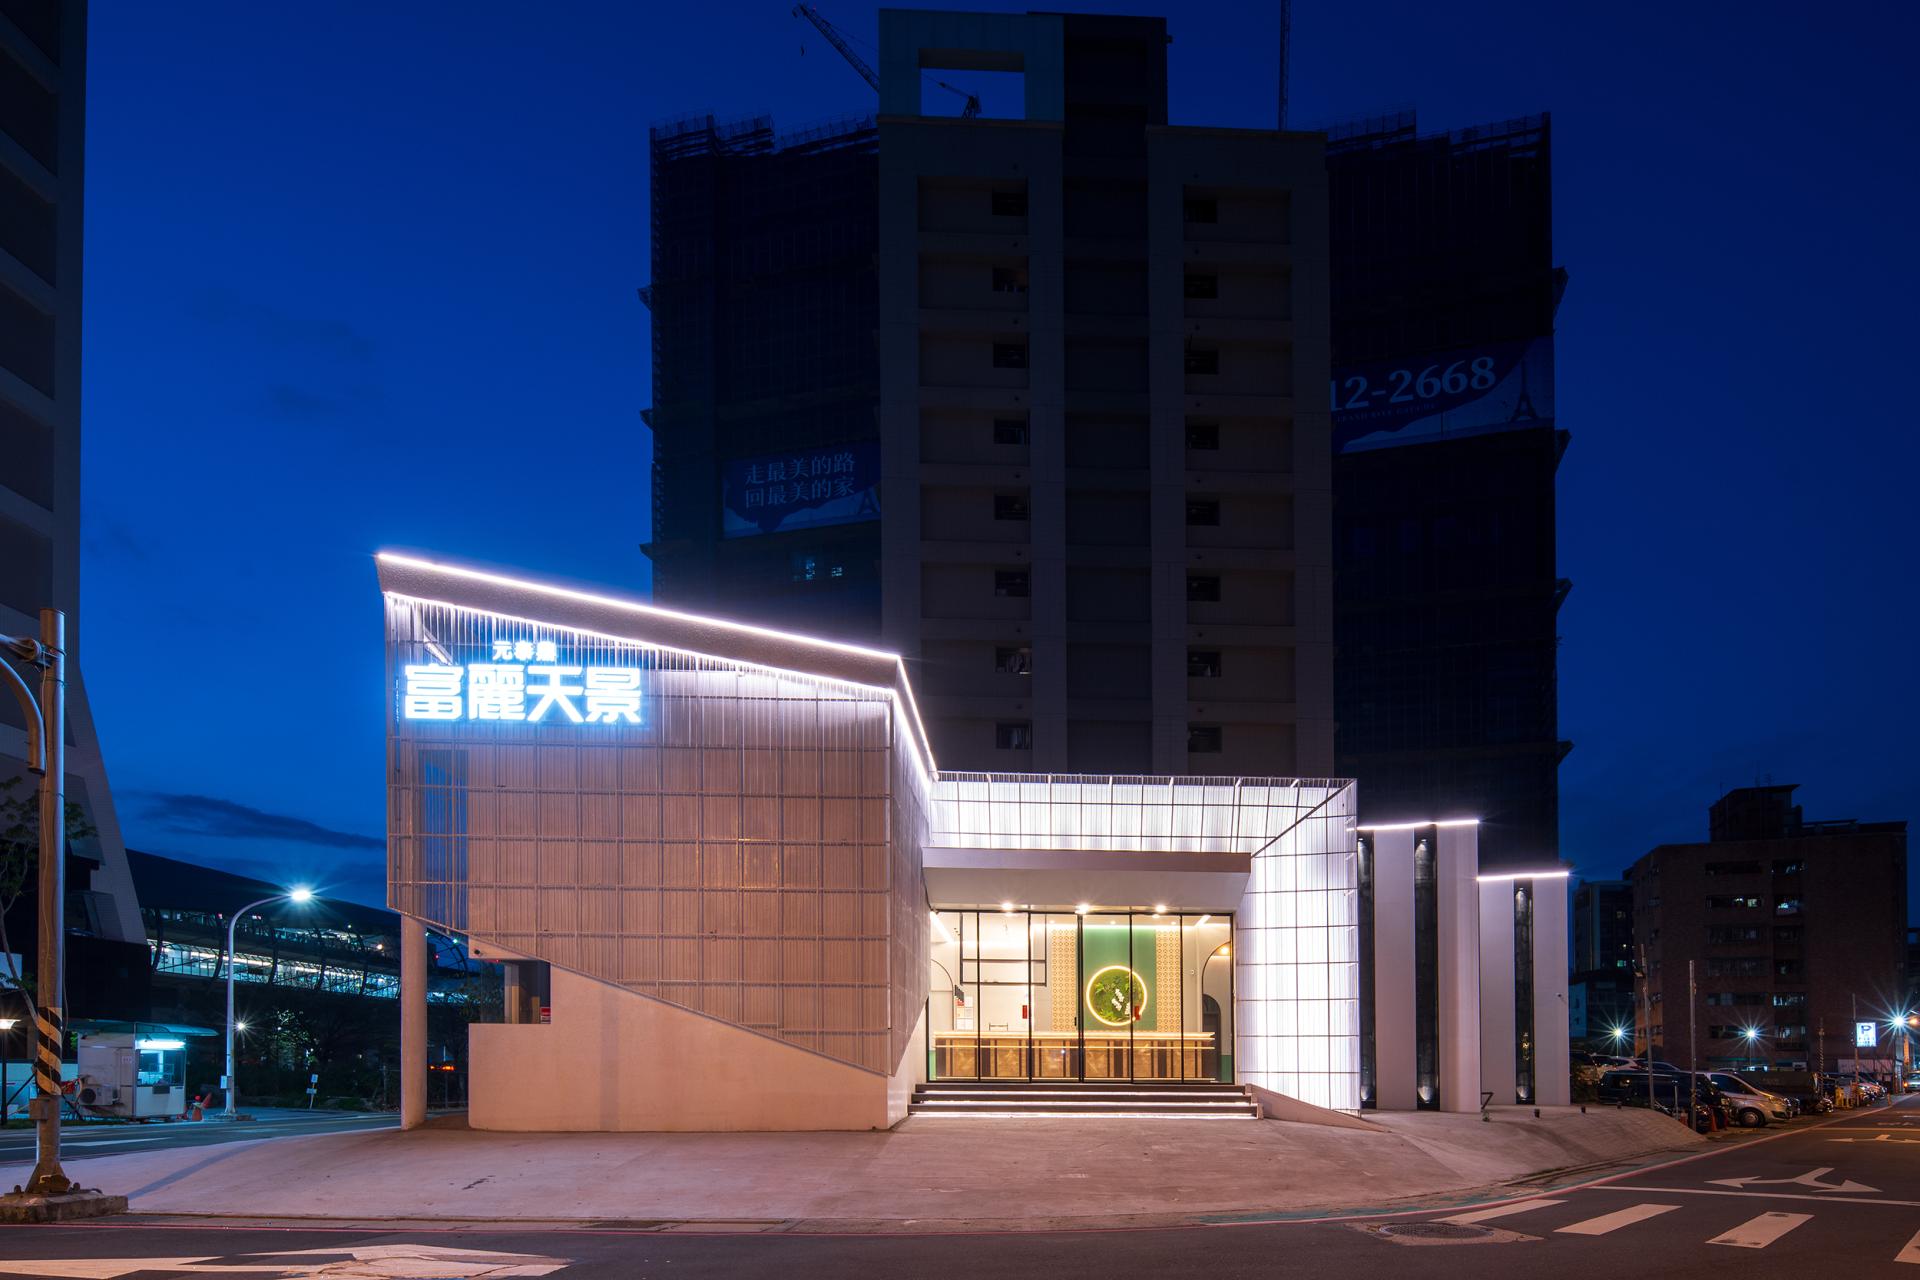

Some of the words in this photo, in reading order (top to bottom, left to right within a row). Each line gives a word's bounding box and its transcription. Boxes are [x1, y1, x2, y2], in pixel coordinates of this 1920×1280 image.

[744, 451, 856, 485] 走最美的路
[744, 477, 855, 509] 回最美的家
[404, 663, 643, 724] 富麗天景
[1861, 1025, 1872, 1034] P
